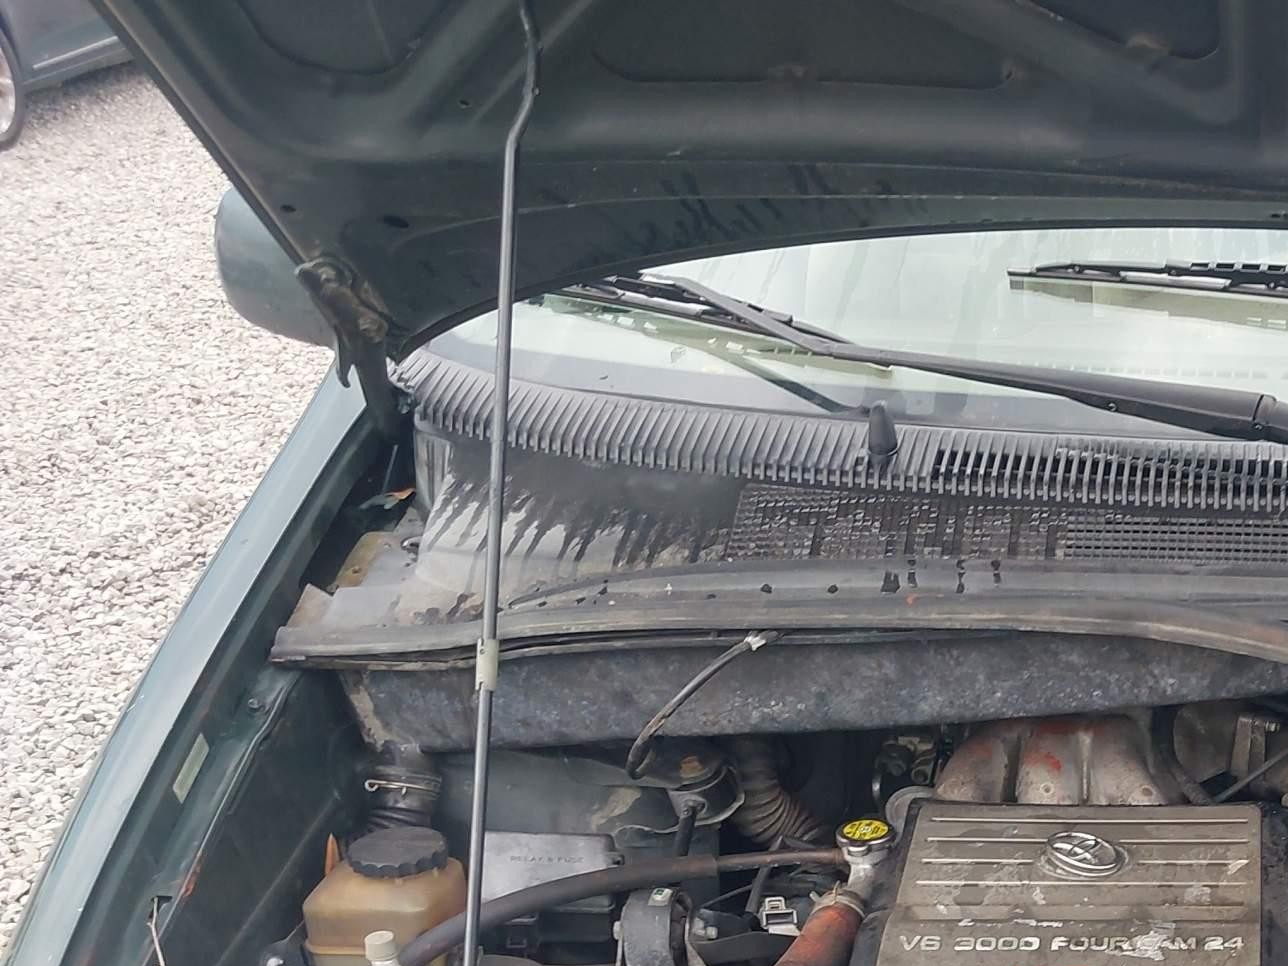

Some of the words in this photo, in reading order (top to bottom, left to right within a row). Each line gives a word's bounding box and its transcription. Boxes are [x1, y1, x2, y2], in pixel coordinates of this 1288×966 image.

[899, 935, 942, 951] V6
[953, 936, 1041, 951] 3000
[1051, 936, 1131, 951] FOUR
[1203, 936, 1244, 951] 24
